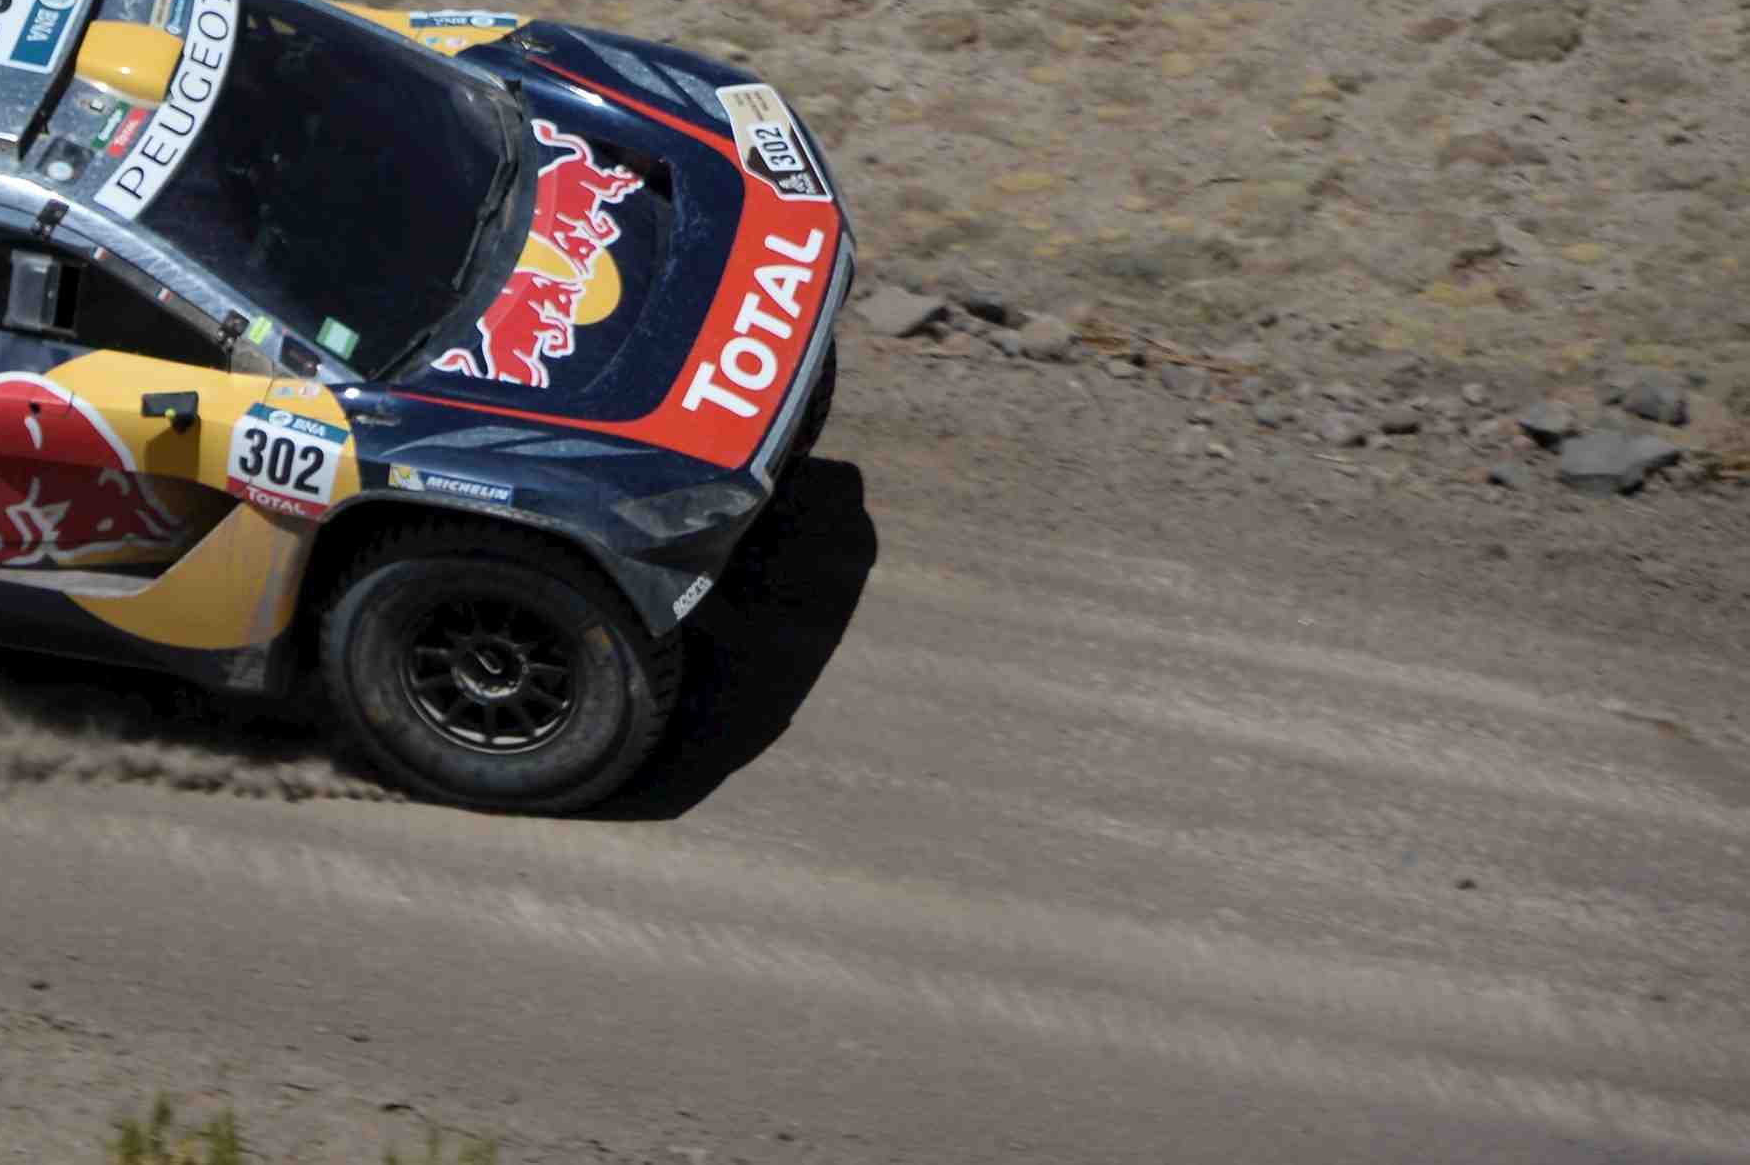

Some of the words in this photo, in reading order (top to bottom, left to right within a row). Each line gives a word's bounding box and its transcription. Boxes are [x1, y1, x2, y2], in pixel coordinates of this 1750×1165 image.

[755, 127, 796, 165] 302
[682, 228, 824, 418] TOTAL
[239, 428, 325, 495] 302
[246, 485, 307, 516] TOTAL
[426, 476, 510, 500] MICHELIN
